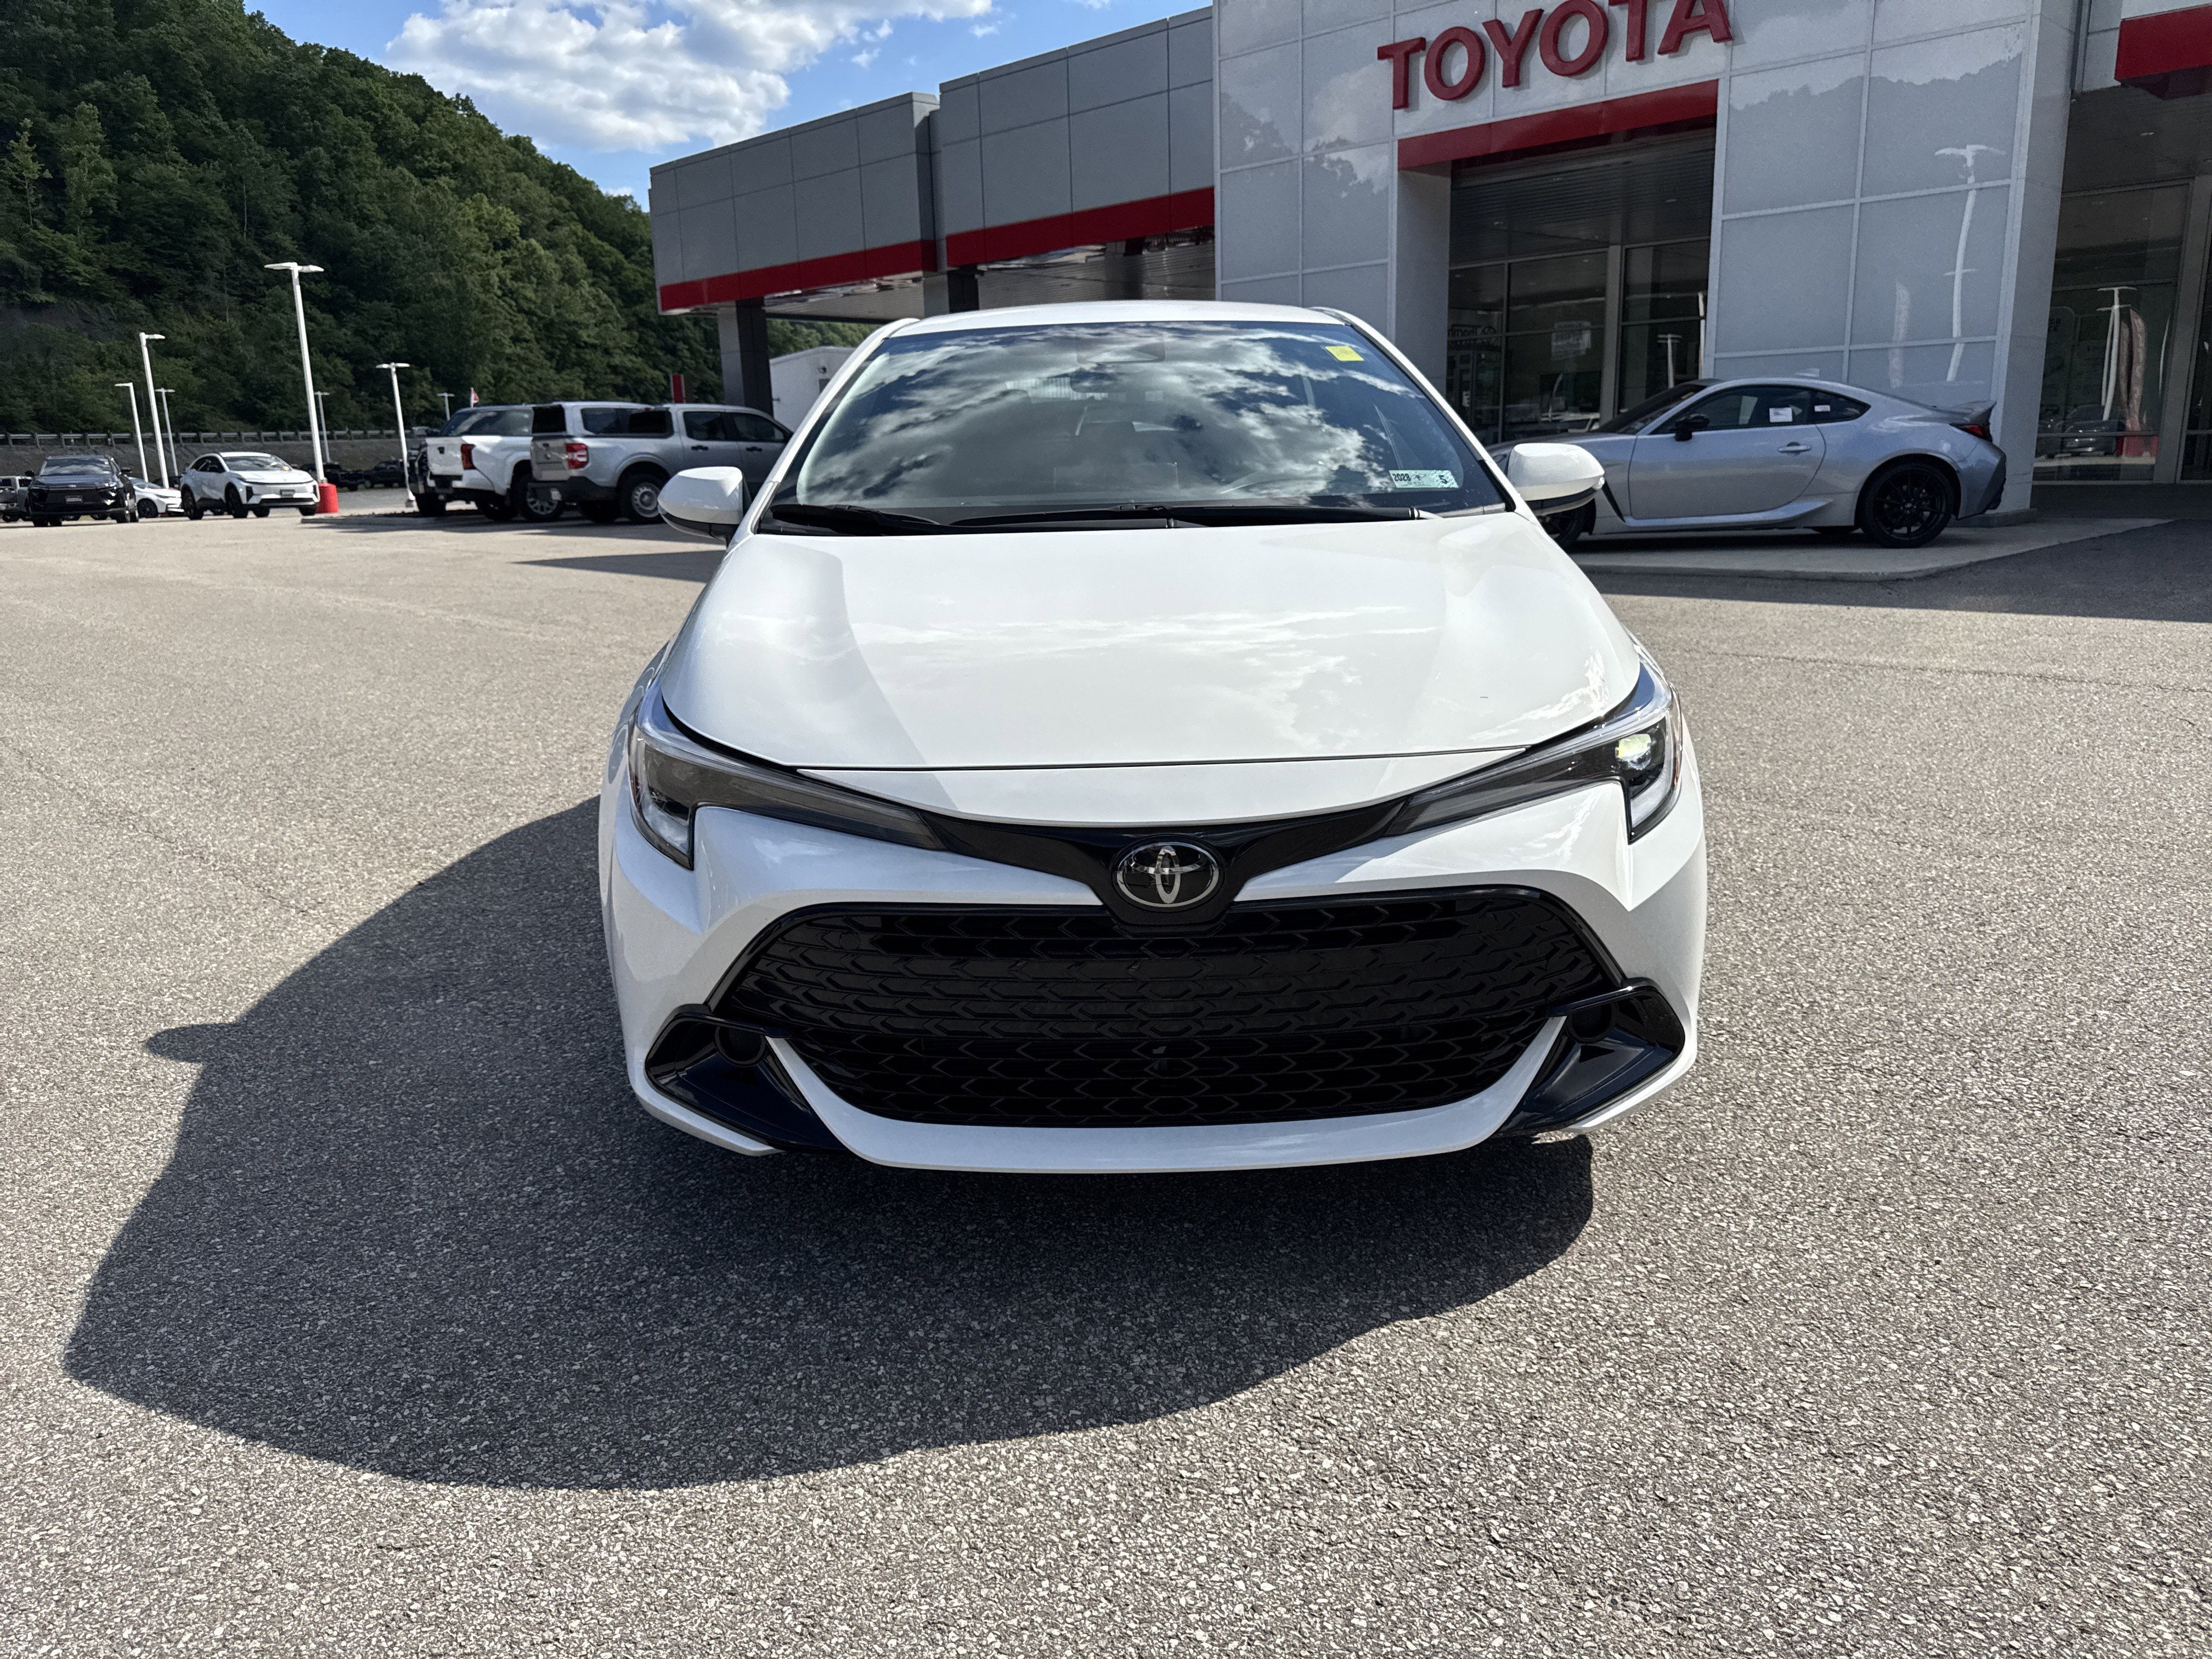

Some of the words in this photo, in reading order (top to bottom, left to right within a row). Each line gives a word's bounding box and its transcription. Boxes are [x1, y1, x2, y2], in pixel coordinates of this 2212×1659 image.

[1377, 0, 1733, 110] TOYOTA
[1392, 473, 1412, 482] 2028
[1438, 475, 1448, 484] 5
